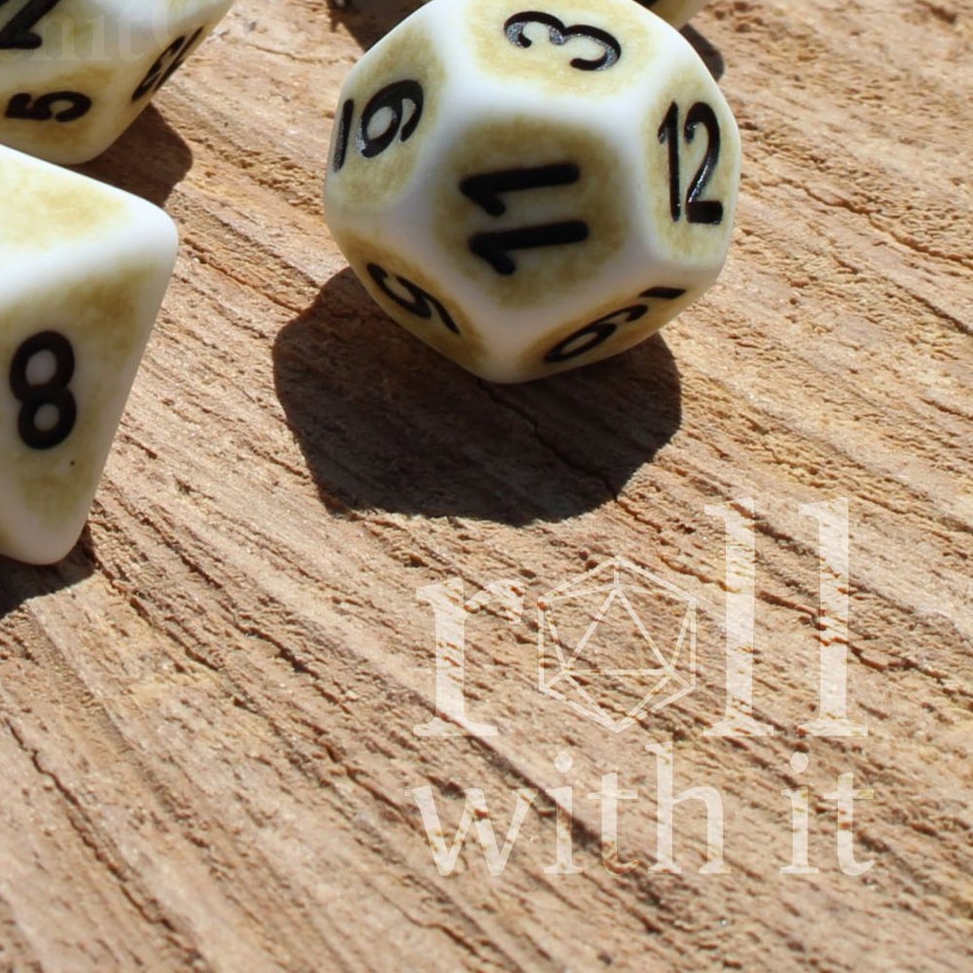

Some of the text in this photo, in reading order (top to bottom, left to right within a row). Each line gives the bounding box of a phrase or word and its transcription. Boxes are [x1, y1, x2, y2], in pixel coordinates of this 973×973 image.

[504, 10, 621, 72] 3
[4, 91, 92, 122] 5
[658, 101, 723, 225] 12
[459, 163, 589, 276] 11
[9, 330, 77, 450] 8
